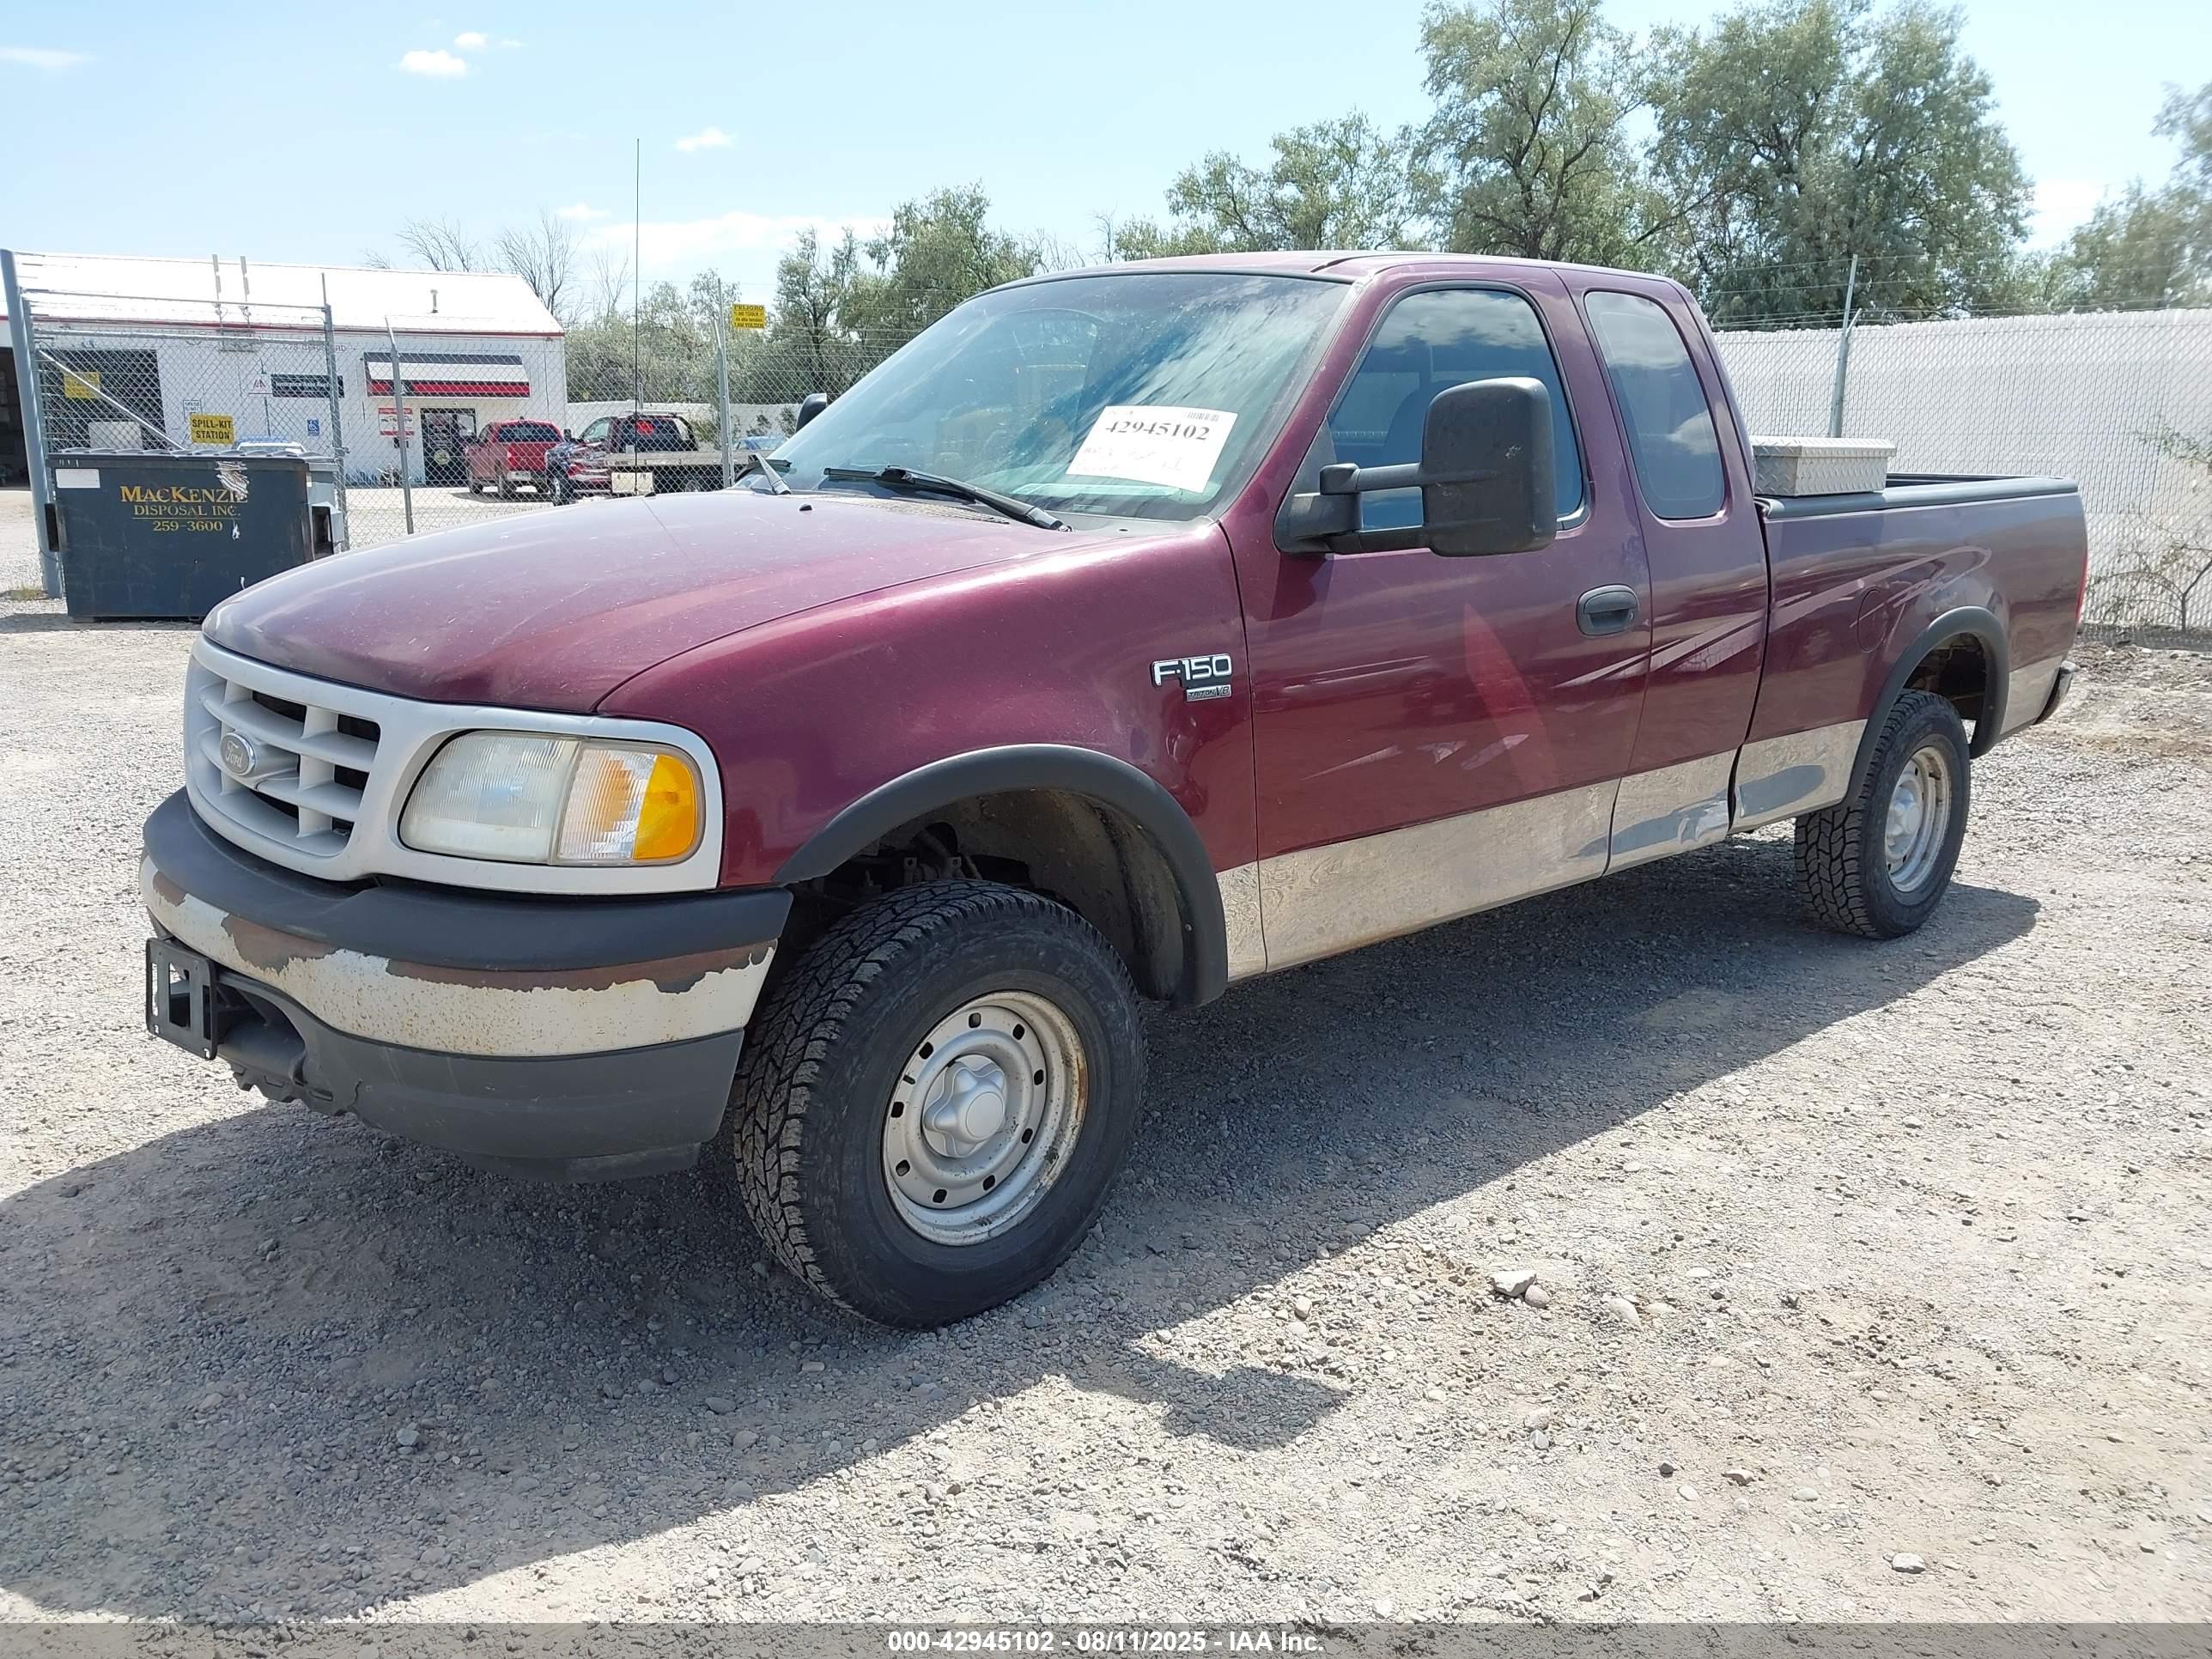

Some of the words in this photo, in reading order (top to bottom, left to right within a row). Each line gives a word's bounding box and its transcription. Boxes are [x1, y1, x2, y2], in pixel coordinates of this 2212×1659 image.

[192, 418, 232, 428] SPILL-KIT
[196, 430, 230, 440] STATION
[1105, 420, 1210, 441] 42945102
[134, 504, 208, 516] DISPOSAL
[153, 520, 223, 532] 259-3600
[225, 740, 244, 769] Ford
